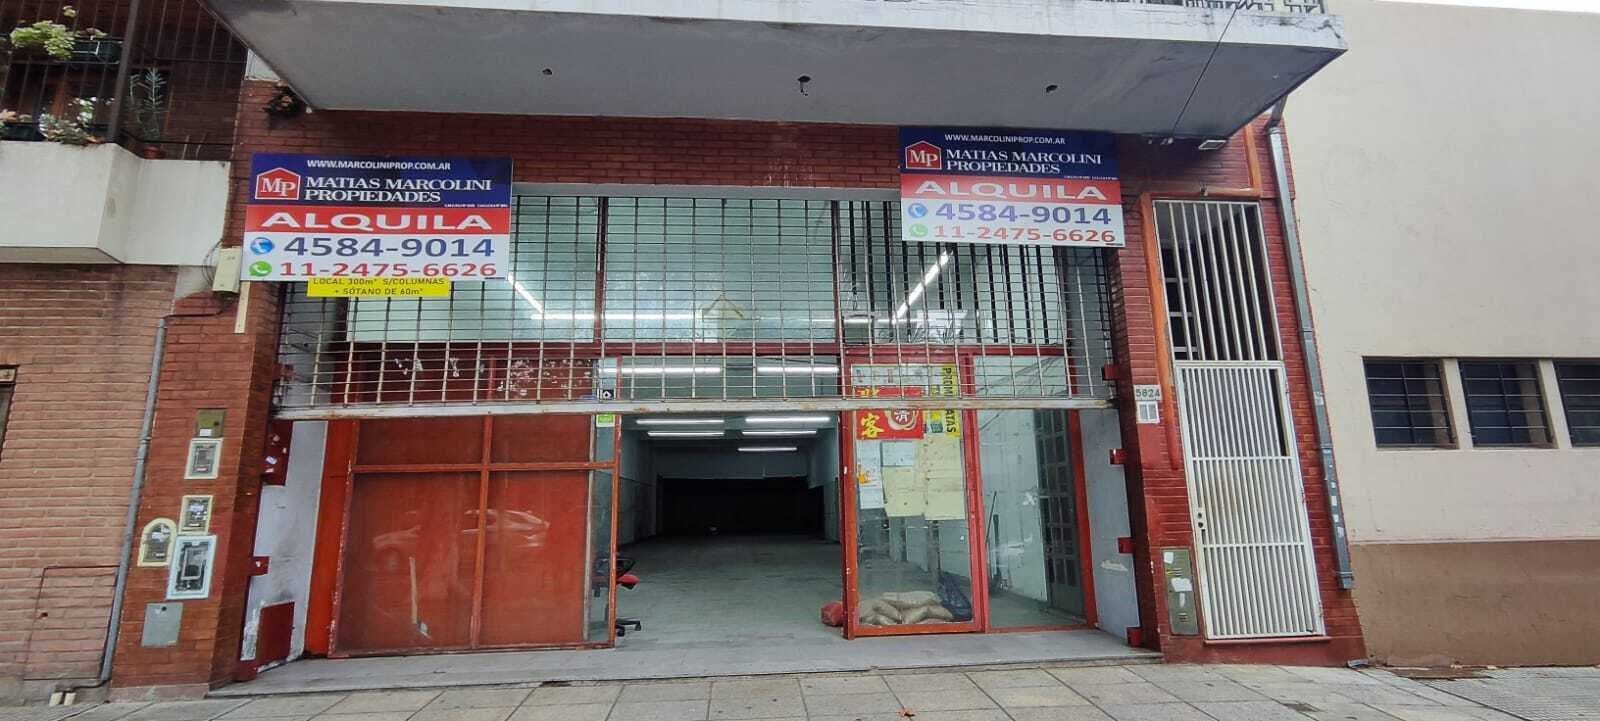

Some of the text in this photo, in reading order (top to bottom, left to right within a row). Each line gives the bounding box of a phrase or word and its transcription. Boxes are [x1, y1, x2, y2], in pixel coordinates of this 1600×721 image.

[944, 132, 1066, 144] WWW.MARCOLINIPROP.COM.AR
[909, 149, 938, 167] MP
[946, 148, 1102, 165] MATIAS MARCOLINI
[307, 159, 451, 171] WWW.MARCOLINIPROP.COM.AR
[946, 160, 1061, 174] PROPIEDADES
[260, 177, 296, 197] MP
[306, 176, 492, 191] MATIAS MARCOLINI
[914, 180, 1107, 200] ALQUILA
[305, 190, 441, 203] PROPIEDADES
[935, 202, 1112, 225] 4584-9014
[260, 212, 493, 232] ALQUILA
[933, 224, 1117, 243] 11-2475-6626
[283, 236, 495, 257] 4584-9014
[279, 261, 497, 277] 11-2475-6626
[313, 278, 345, 286] LOCAL
[383, 278, 445, 286] S/COLUMNAS
[384, 288, 397, 296] DE
